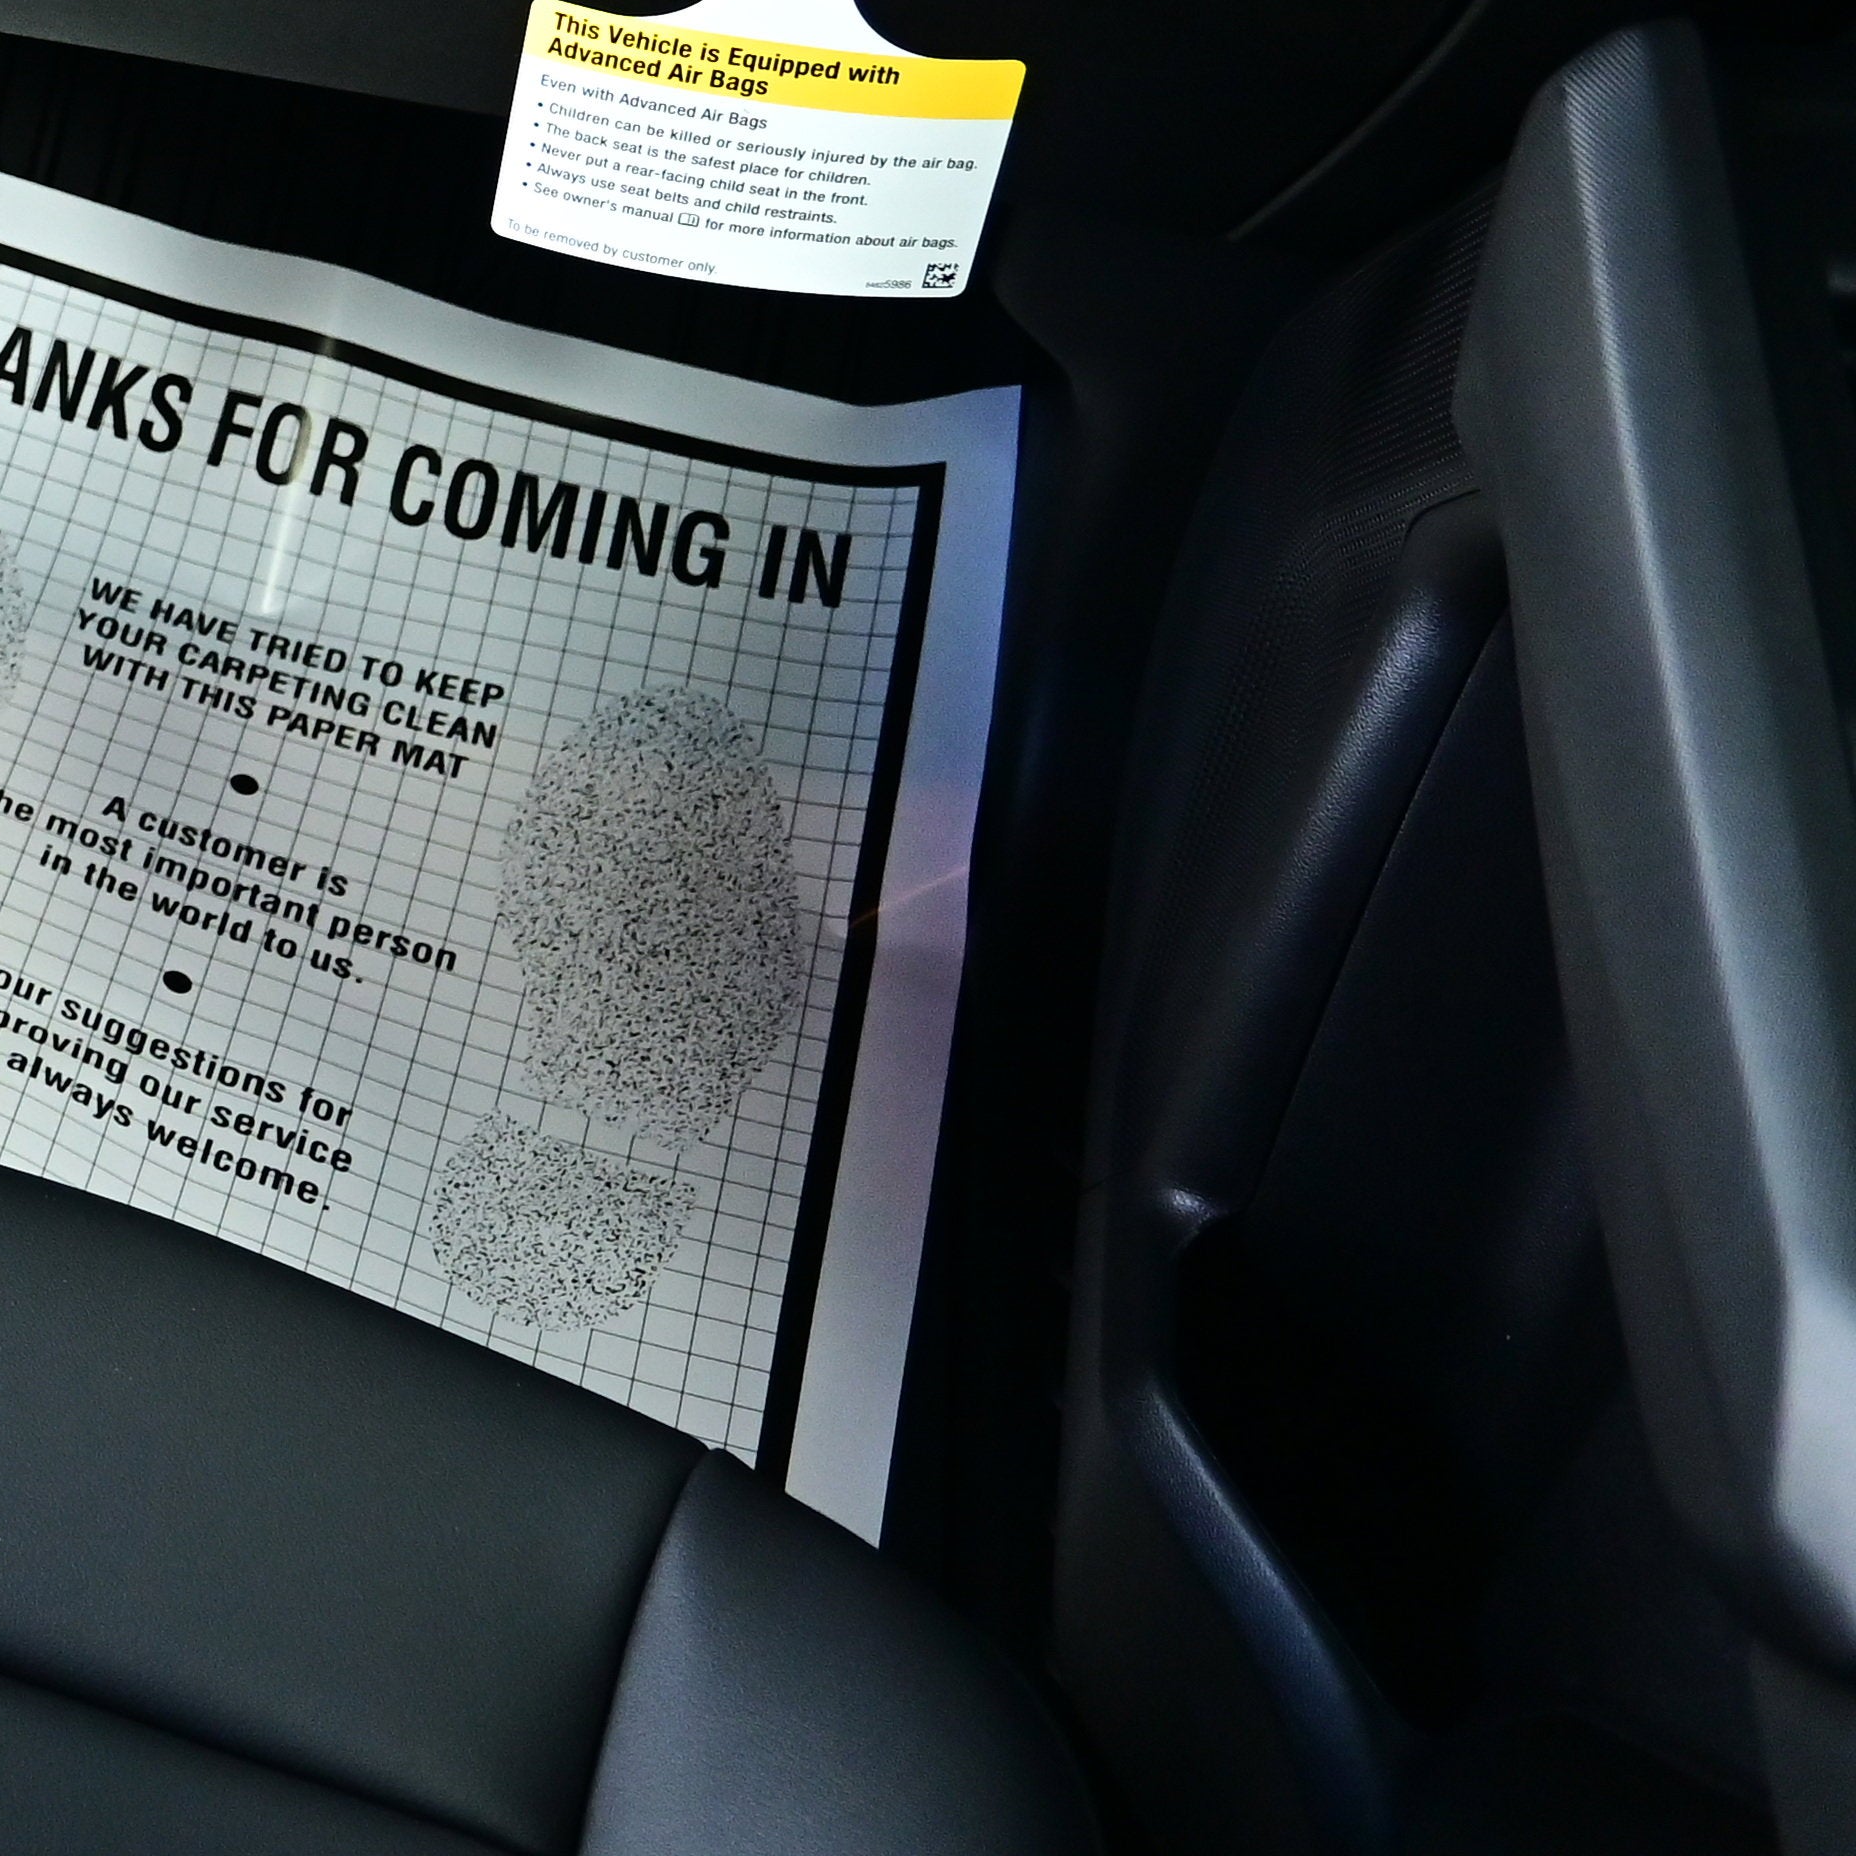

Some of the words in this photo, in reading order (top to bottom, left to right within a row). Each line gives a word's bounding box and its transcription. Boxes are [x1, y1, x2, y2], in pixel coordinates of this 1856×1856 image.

[548, 37, 662, 78] Advanced
[668, 63, 703, 85] Air
[710, 69, 769, 97] Bags
[555, 11, 600, 40] This
[609, 25, 693, 58] Vehicle
[700, 43, 720, 63] is
[728, 47, 841, 79] Equipped
[848, 65, 900, 85] with
[541, 74, 576, 93] Even
[582, 86, 615, 102] with
[619, 93, 696, 118] Advanced
[701, 108, 724, 122] Air
[729, 111, 768, 131] Bags
[549, 102, 610, 126] Children
[615, 119, 641, 133] can
[646, 124, 665, 138] be
[670, 128, 711, 146] killed
[716, 138, 732, 149] or
[736, 140, 806, 160] seriously
[811, 148, 865, 165] injured
[870, 154, 888, 168] by
[893, 156, 917, 169] the
[921, 157, 943, 169] air
[946, 157, 978, 172] bag.
[537, 162, 586, 185] Always
[591, 177, 616, 191] use
[620, 182, 650, 198] seat
[654, 189, 689, 205] belts
[694, 196, 721, 212] and
[725, 200, 760, 216] child
[765, 207, 837, 224] restraints.
[541, 142, 582, 162] Never
[585, 154, 608, 169] put
[612, 161, 621, 172] a
[625, 164, 705, 189] rear-facing
[709, 178, 745, 193] child
[749, 184, 780, 198] seat
[785, 187, 798, 199] in
[803, 189, 826, 202] the
[831, 192, 868, 206] front.
[546, 122, 570, 138] The
[575, 128, 608, 147] back
[613, 139, 642, 155] seat
[647, 145, 659, 158] is
[664, 148, 687, 163] the
[691, 154, 736, 171] safest
[739, 161, 779, 177] place
[784, 166, 805, 179] for
[808, 169, 871, 186] children.
[508, 218, 521, 232] To
[525, 224, 539, 236] be
[544, 230, 599, 252] removed
[603, 242, 619, 257] by
[622, 248, 684, 269] customer
[688, 261, 717, 275] only.
[534, 182, 559, 198] See
[563, 191, 618, 212] owner's
[622, 204, 674, 223] manual
[705, 218, 725, 232] for
[729, 224, 765, 237] more
[769, 226, 851, 245] information
[855, 235, 895, 248] about
[899, 236, 918, 248] air
[921, 237, 958, 251] bags.
[206, 390, 369, 507] FOR
[389, 444, 730, 589] COMING
[758, 524, 852, 609] IN
[77, 608, 168, 656] YOUR
[177, 642, 371, 717] CARPETING
[381, 700, 498, 749] CLEAN
[90, 577, 142, 614] WE
[150, 599, 239, 642] HAVE
[249, 629, 347, 674] TRIED
[361, 655, 404, 687] TO
[414, 668, 505, 709] KEEP
[82, 644, 170, 692] WITH
[182, 676, 257, 720] THIS
[266, 705, 381, 757] PAPER
[391, 739, 469, 779] MAT
[45, 812, 133, 863] most
[141, 845, 321, 929] important
[326, 910, 460, 972] person
[101, 796, 128, 822] A
[138, 810, 307, 882] customer
[316, 866, 350, 898] is
[39, 844, 72, 875] in
[83, 863, 139, 902] the
[150, 891, 253, 945] world
[263, 928, 298, 961] to
[310, 949, 364, 984] us.
[60, 994, 287, 1104] suggestions
[299, 1086, 354, 1129] for
[6, 1051, 135, 1129] always
[147, 1118, 331, 1212] welcome.
[139, 1074, 202, 1116] our
[211, 1104, 355, 1174] service
